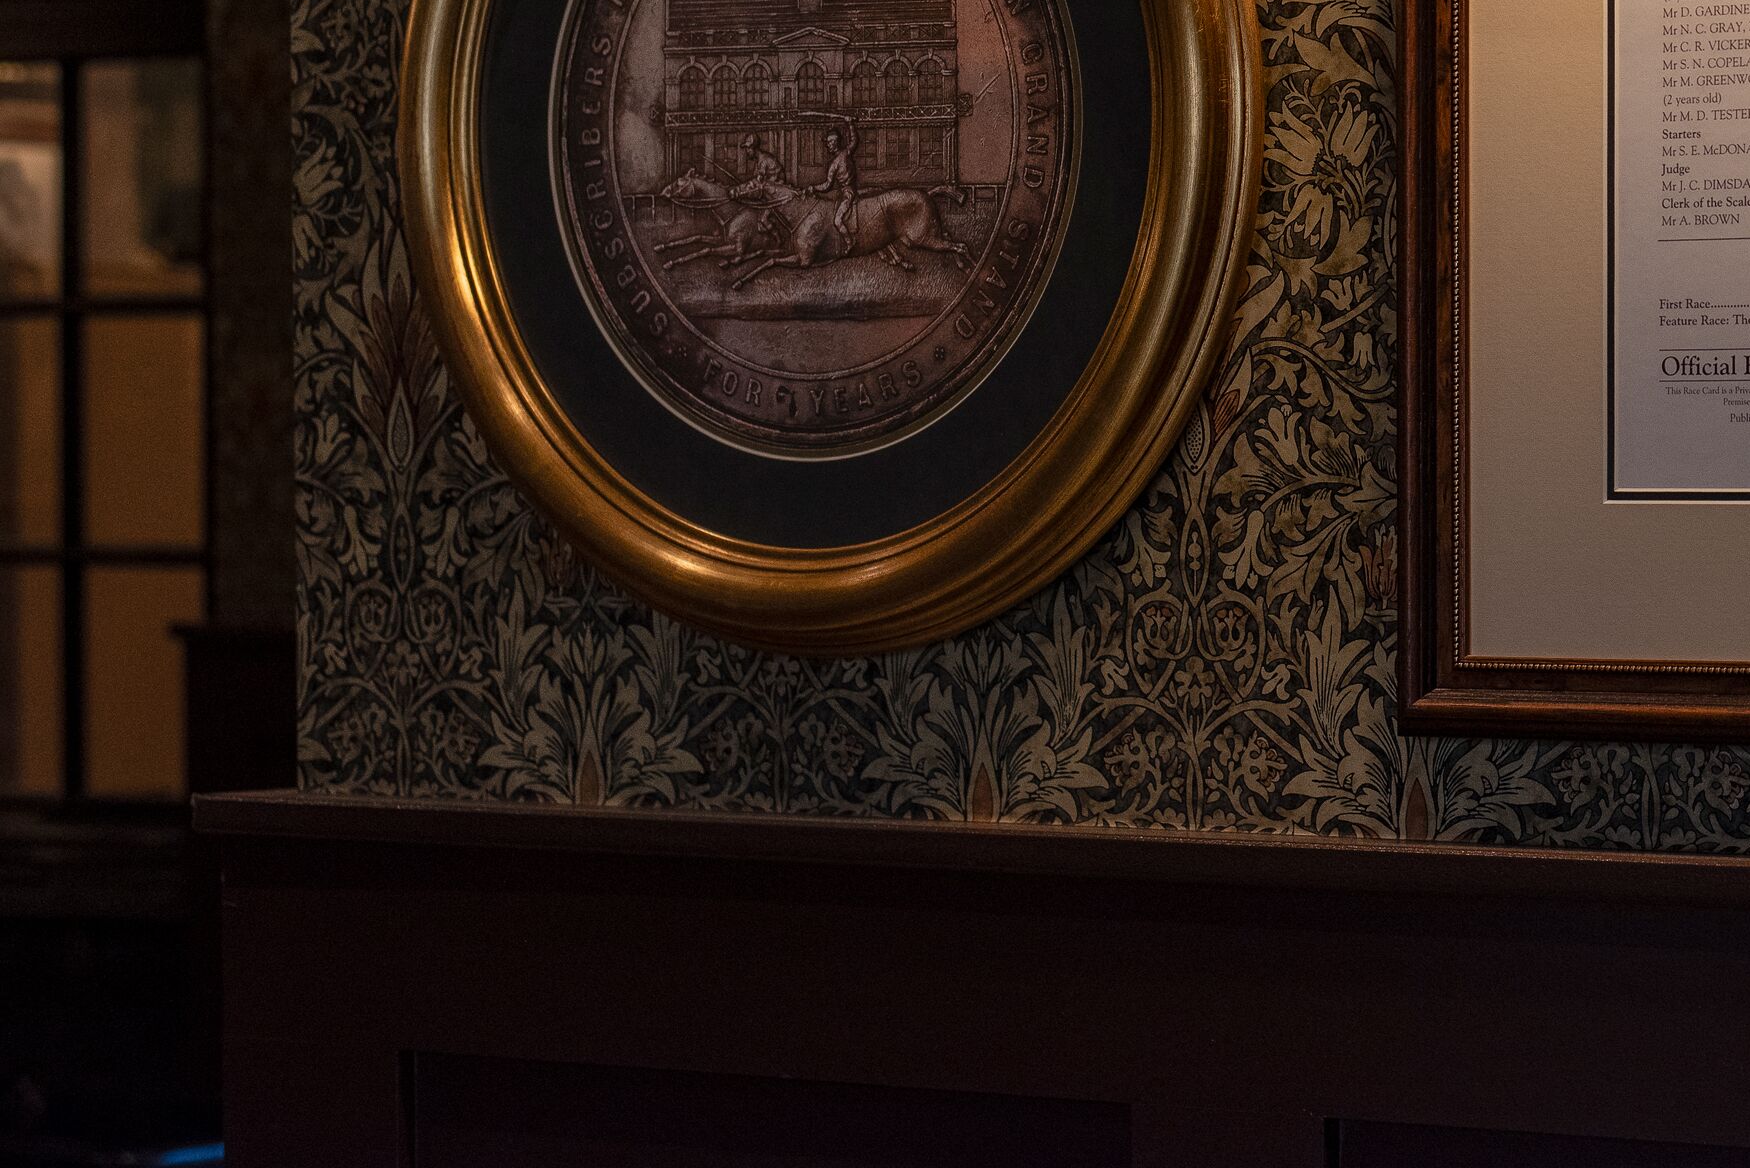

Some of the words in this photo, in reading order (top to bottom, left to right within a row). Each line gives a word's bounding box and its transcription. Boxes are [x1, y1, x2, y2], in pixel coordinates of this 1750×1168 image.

[1662, 7, 1677, 18] Mr
[1680, 6, 1692, 17] D.
[1662, 76, 1677, 87] Mr
[1680, 75, 1693, 87] M.
[1020, 42, 1050, 189] GRAND
[1661, 128, 1701, 139] Starters
[1660, 162, 1690, 176] Judge
[1661, 197, 1689, 209] Clerk
[1692, 196, 1704, 208] of
[1706, 196, 1722, 207] the
[1661, 215, 1676, 226] Mr
[1678, 215, 1691, 225] A.
[1694, 213, 1739, 225] BROWN
[954, 216, 1032, 341] STAND
[1659, 298, 1682, 309] First
[1658, 315, 1697, 326] Feature
[1700, 314, 1729, 325] Race:
[1661, 354, 1736, 376] Official
[701, 357, 764, 409] FOR
[809, 359, 925, 418] YEARS
